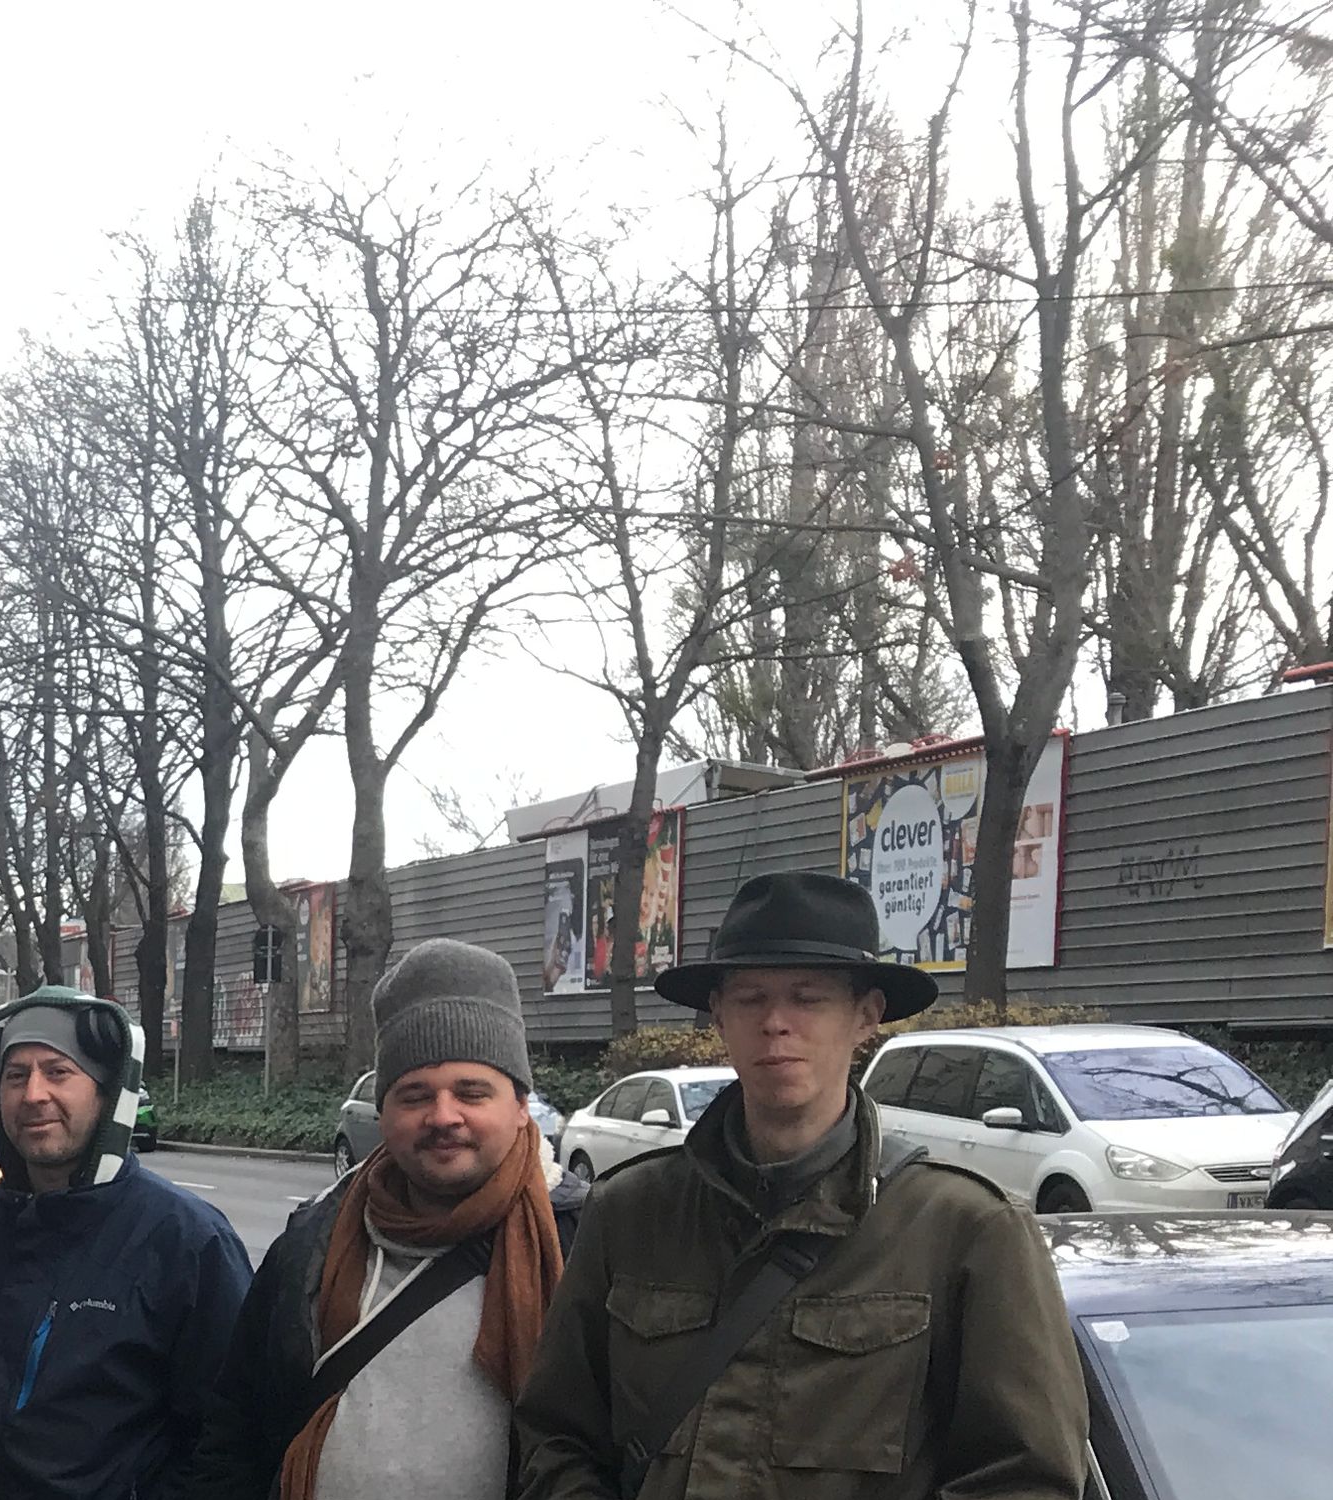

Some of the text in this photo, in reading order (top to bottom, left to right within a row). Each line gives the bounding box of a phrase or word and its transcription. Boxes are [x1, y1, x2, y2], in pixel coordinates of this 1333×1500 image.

[881, 818, 936, 852] clever
[879, 870, 934, 899] garantiert
[884, 892, 926, 919] günstig!
